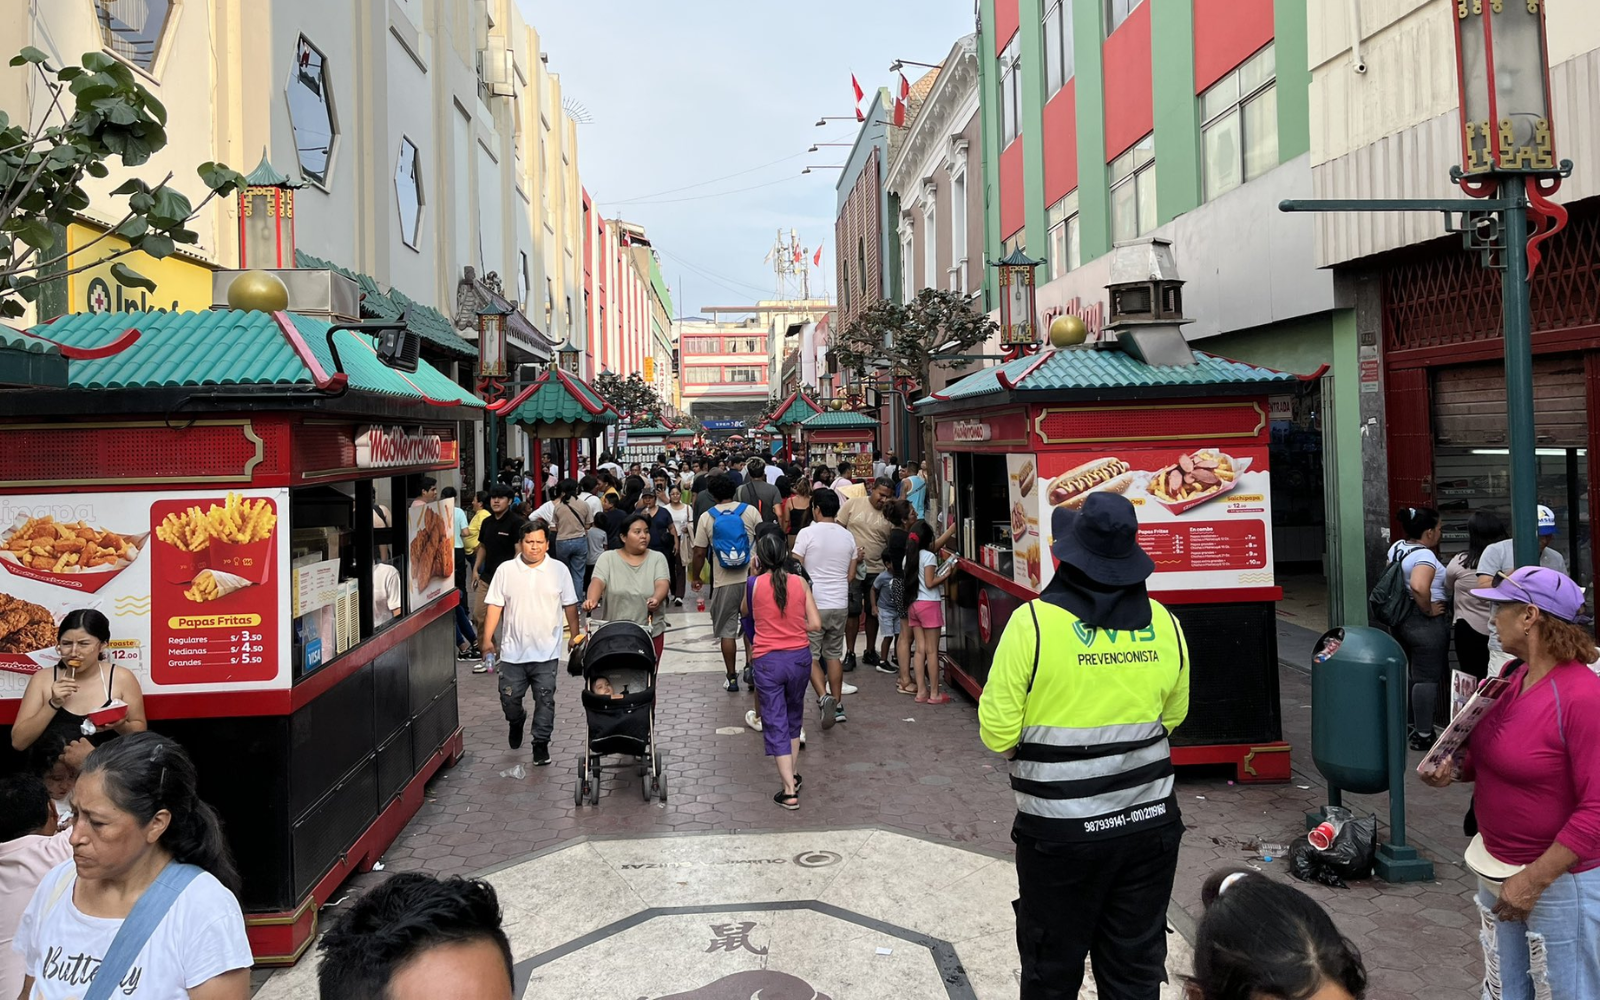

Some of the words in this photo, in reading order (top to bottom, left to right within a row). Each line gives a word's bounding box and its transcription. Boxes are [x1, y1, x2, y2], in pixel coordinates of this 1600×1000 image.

[116, 284, 179, 315] Ink
[178, 618, 215, 629] Papas
[217, 616, 252, 626] Fritas
[107, 640, 138, 648] roaste
[168, 636, 208, 645] Regulares
[241, 631, 263, 642] 3.50
[112, 650, 138, 660] 12.00
[168, 648, 208, 656] Medianas
[241, 642, 264, 653] 4.50
[168, 659, 202, 667] Grandes
[241, 653, 263, 664] 5.50
[307, 651, 321, 666] VISA
[1077, 650, 1160, 666] PREVENCIONISTA
[704, 921, 769, 956] 鼠
[42, 945, 143, 996] Buttey
